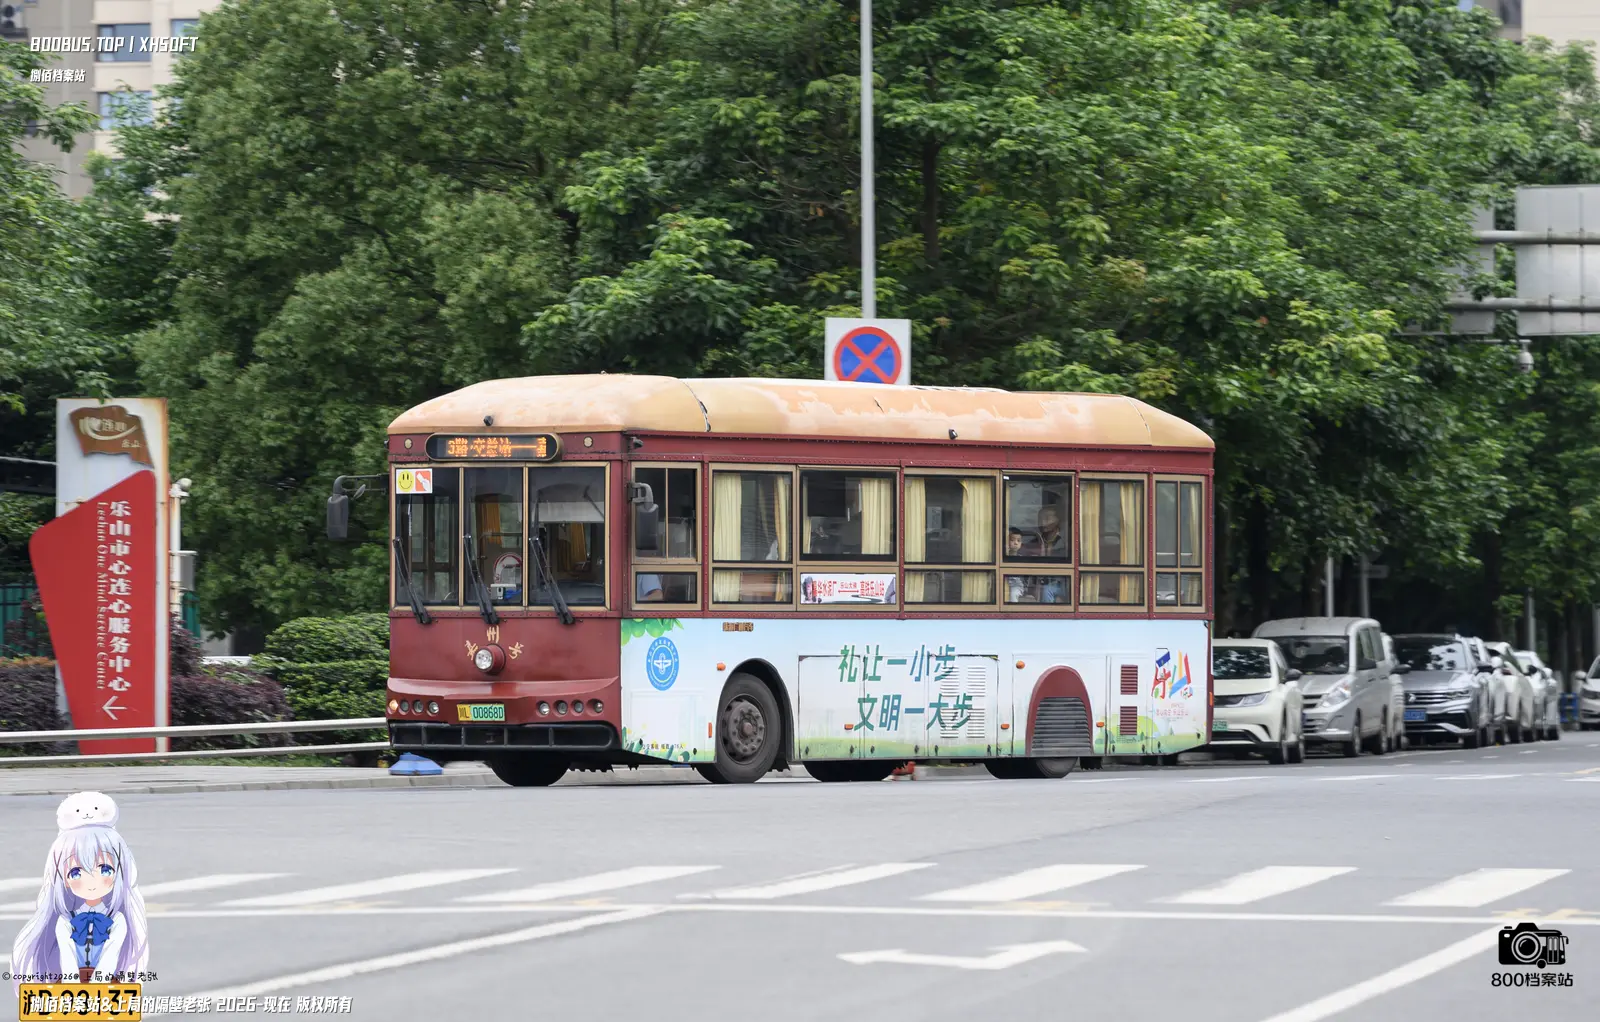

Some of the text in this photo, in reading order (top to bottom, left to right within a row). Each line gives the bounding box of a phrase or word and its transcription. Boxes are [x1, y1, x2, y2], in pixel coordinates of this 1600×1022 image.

[108, 500, 131, 692] 乐山市心连心服务中心
[838, 643, 956, 683] 礼让一小步
[853, 692, 974, 732] 文明一大步
